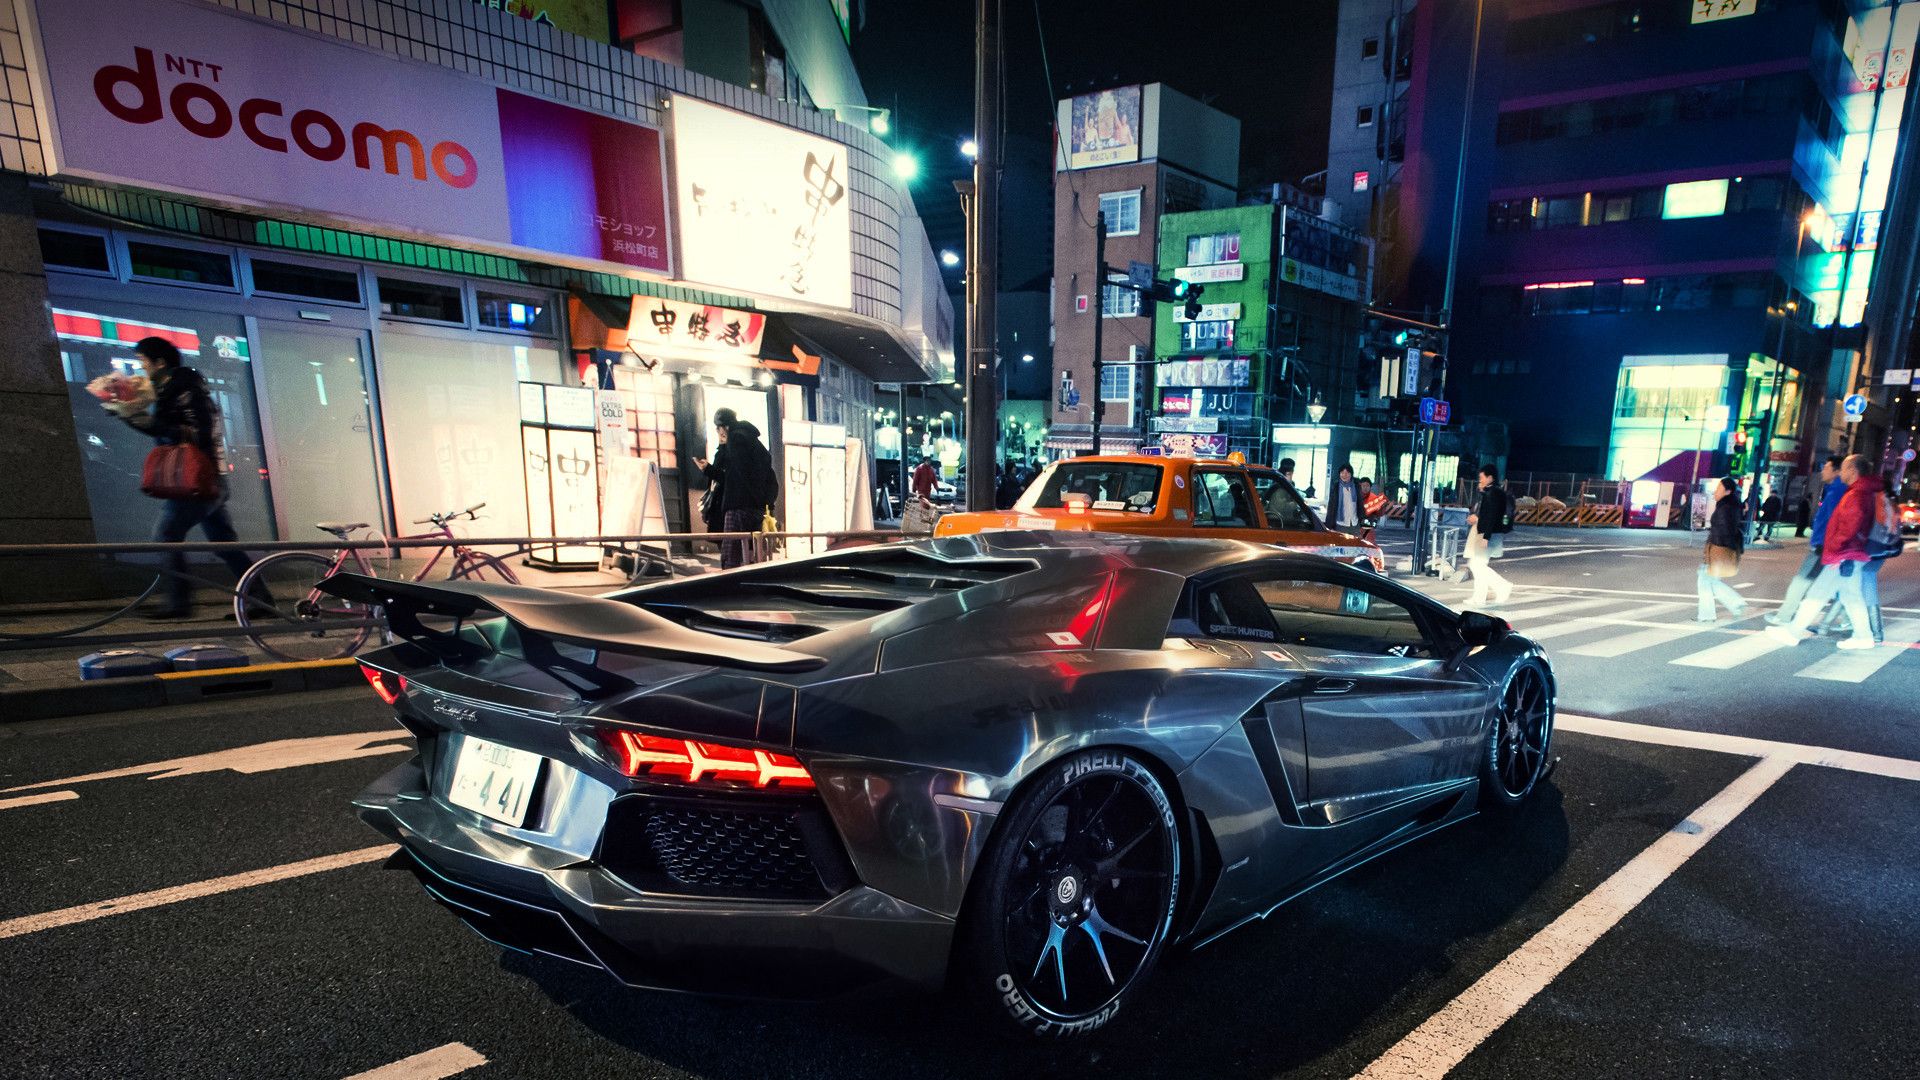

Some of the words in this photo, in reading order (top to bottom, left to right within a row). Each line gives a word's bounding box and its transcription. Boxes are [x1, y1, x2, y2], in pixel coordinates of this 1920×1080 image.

[164, 53, 223, 82] NTT
[93, 46, 478, 189] docomo
[602, 408, 624, 418] COLD
[1062, 754, 1127, 785] PIRELLI
[996, 973, 1038, 1021] ZERO
